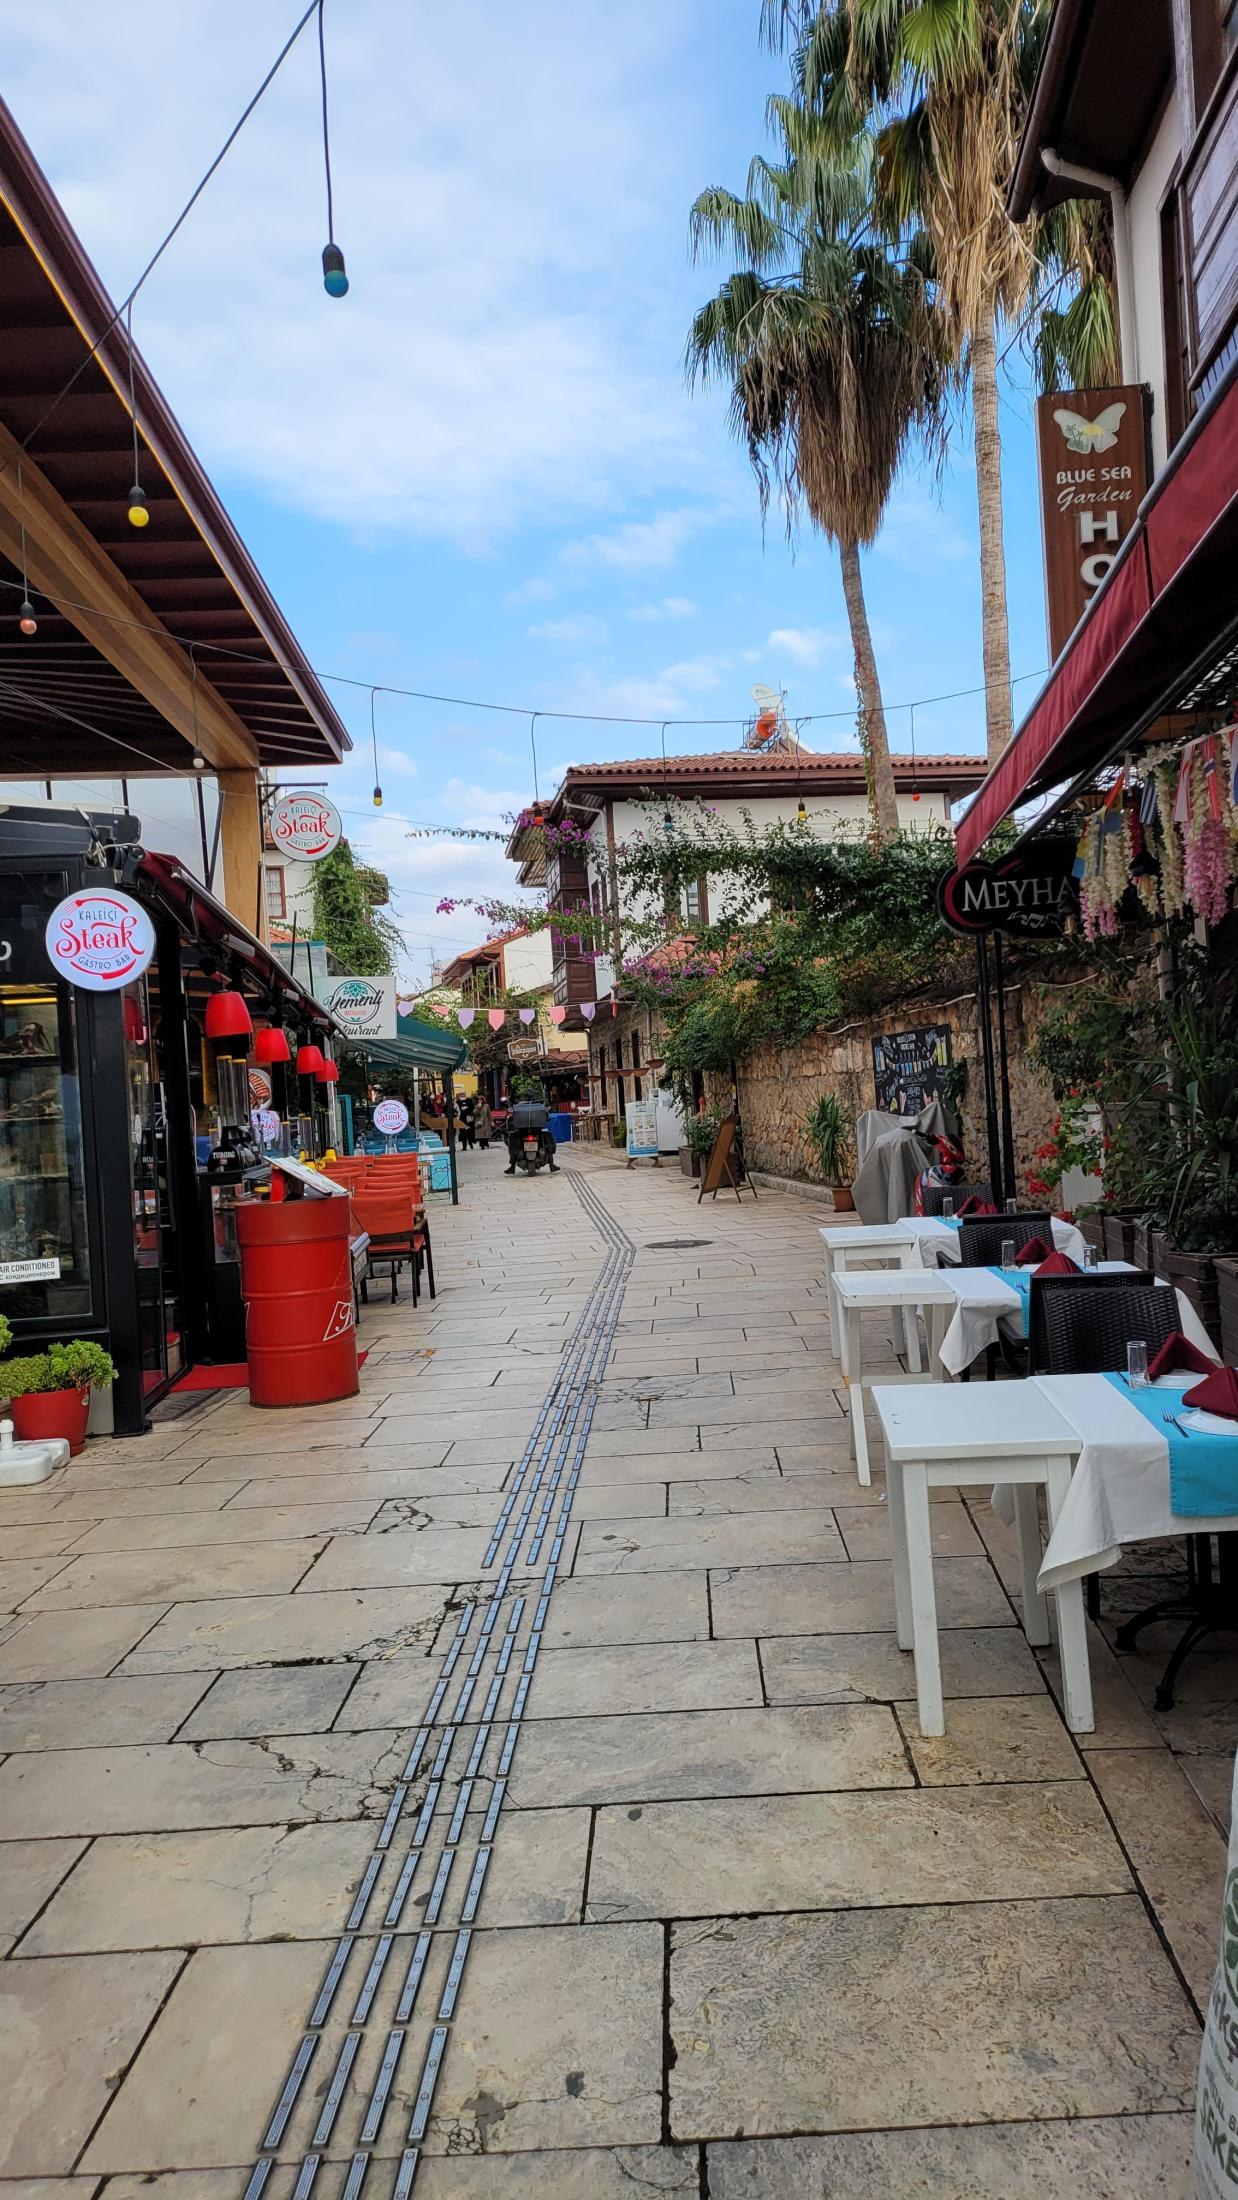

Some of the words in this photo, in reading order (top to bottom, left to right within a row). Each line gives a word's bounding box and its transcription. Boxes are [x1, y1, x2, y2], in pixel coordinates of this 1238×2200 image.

[1056, 468, 1095, 484] BLUE
[1101, 465, 1132, 480] SEA
[1056, 486, 1132, 512] Garden
[1080, 510, 1119, 609] HO
[276, 811, 335, 838] Steak
[56, 916, 145, 958] Steak
[78, 956, 111, 970] GASTRO
[115, 953, 132, 967] BAR
[212, 1150, 235, 1159] TUBORG
[11, 1261, 55, 1272] CONDITIONED
